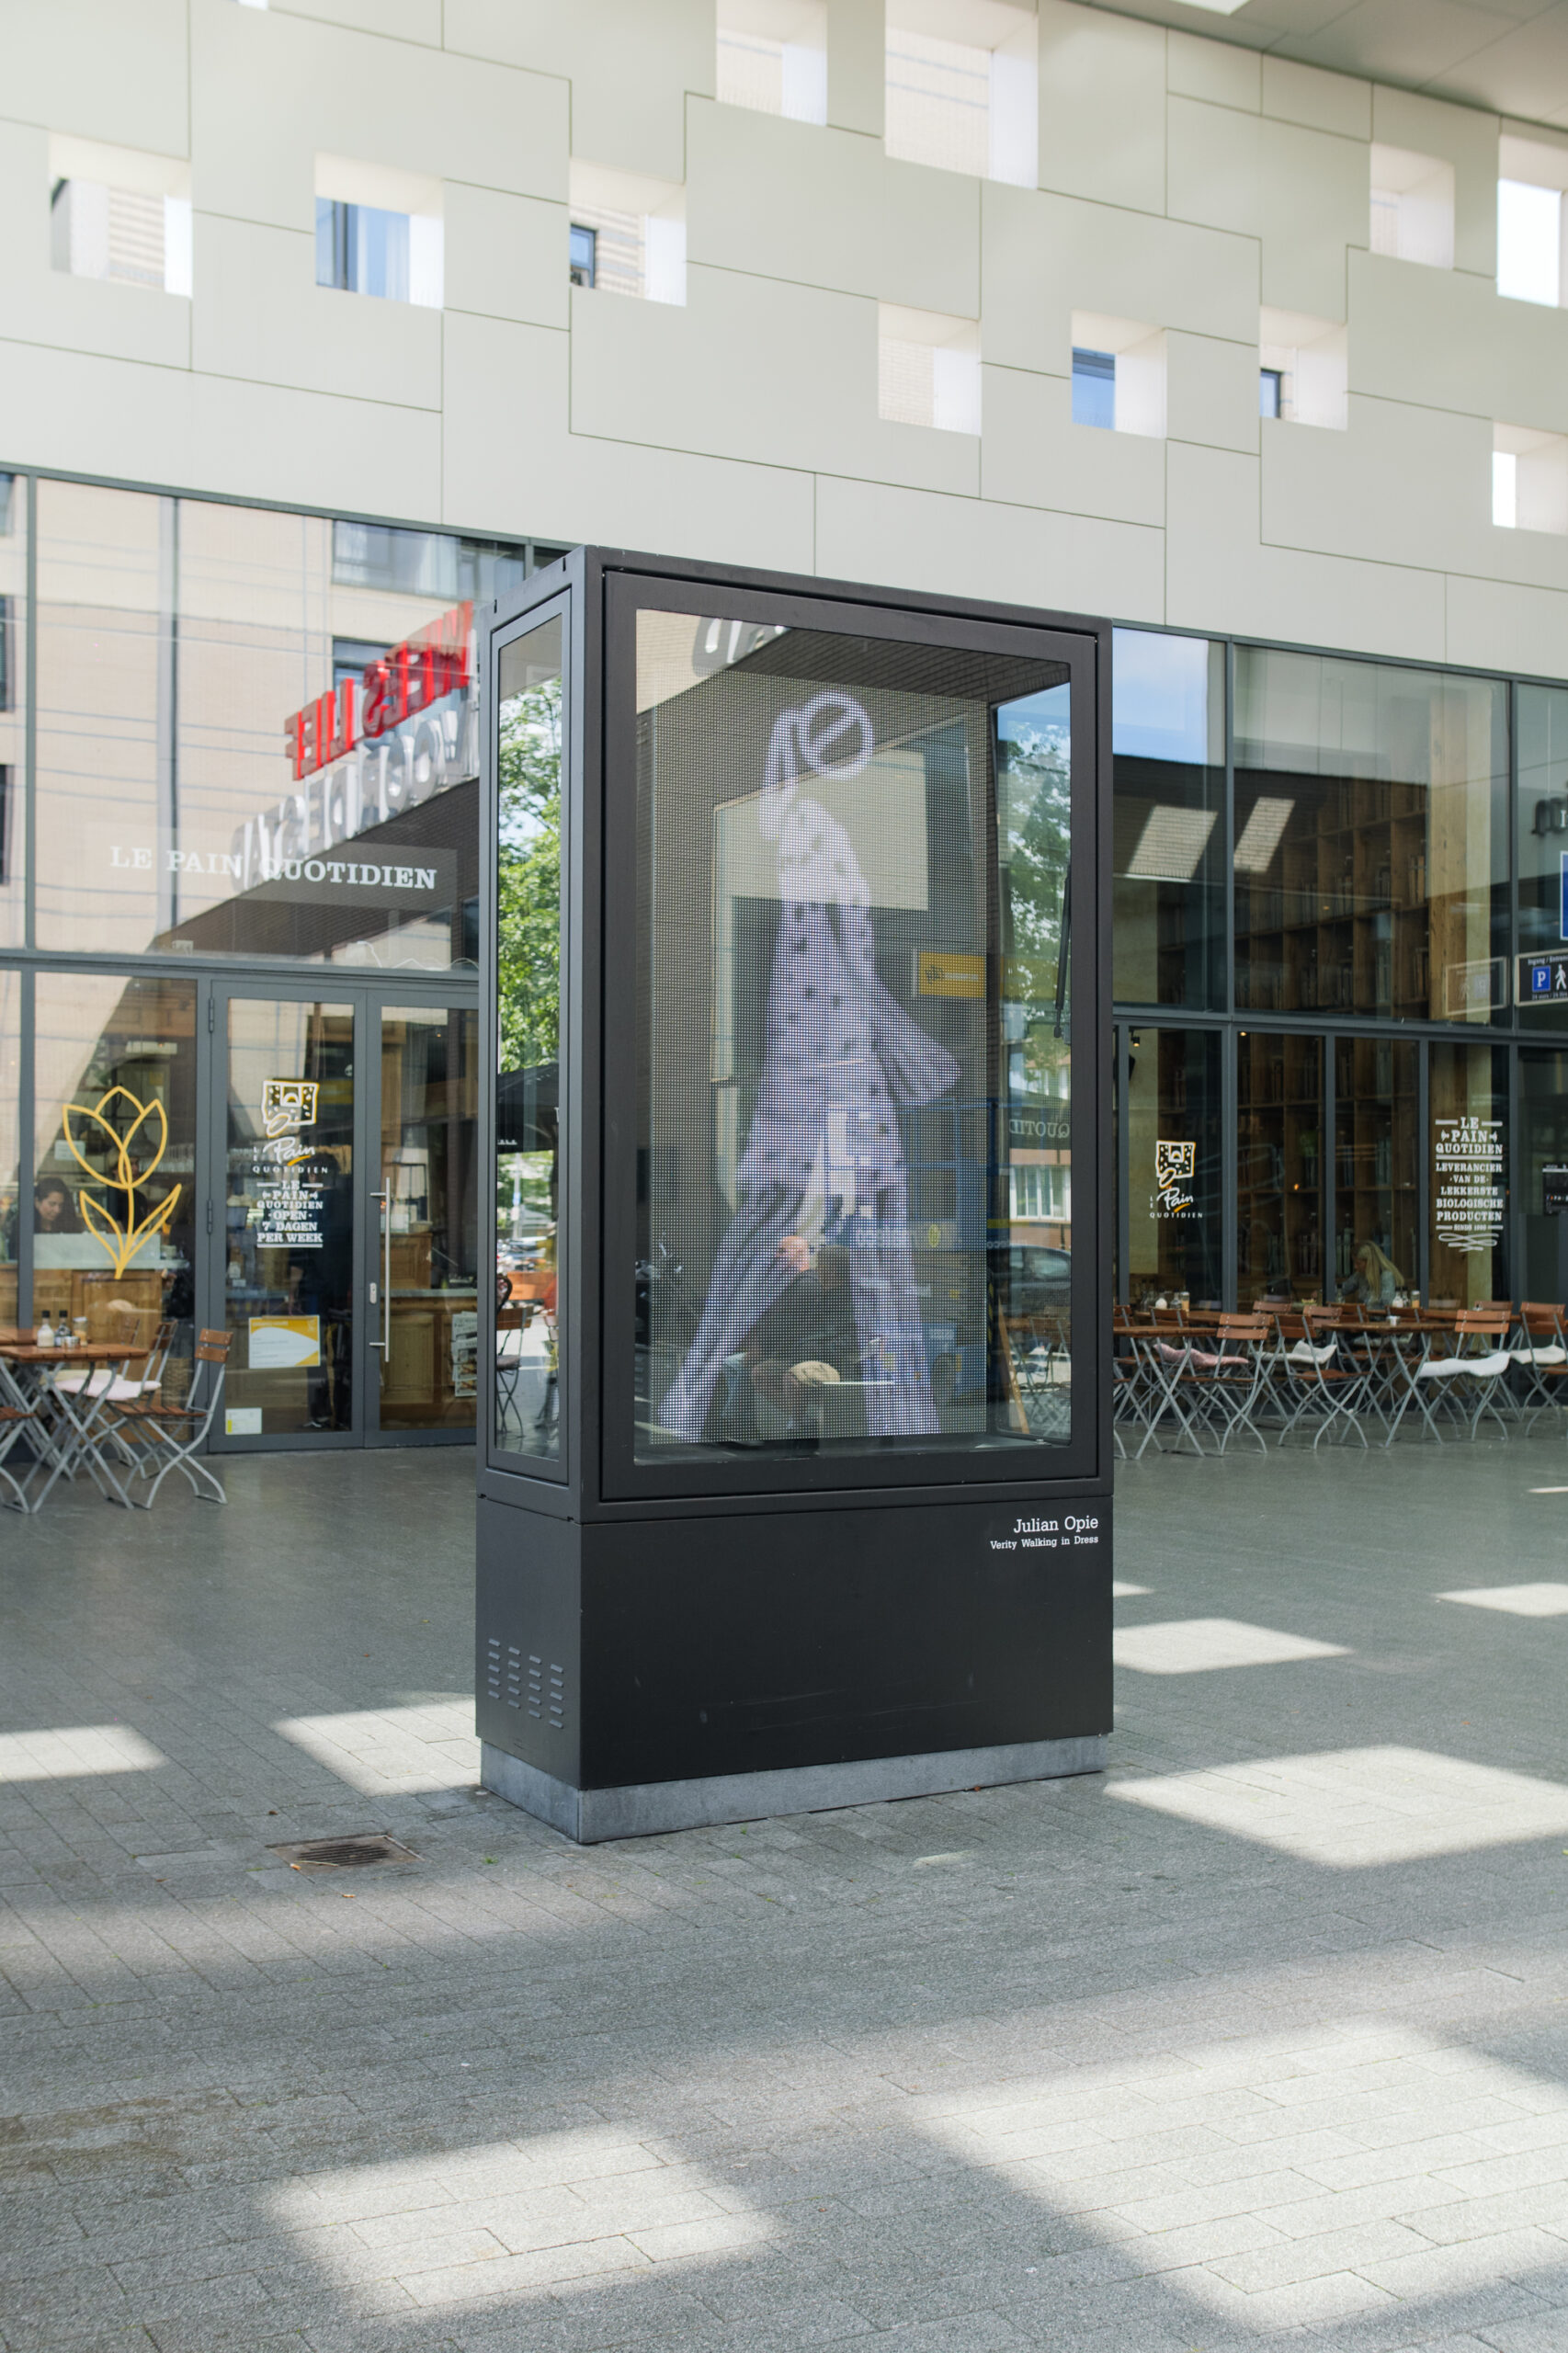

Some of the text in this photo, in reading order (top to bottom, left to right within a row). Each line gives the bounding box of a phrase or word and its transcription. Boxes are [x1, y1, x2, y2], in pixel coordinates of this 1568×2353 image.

[110, 846, 437, 890] LE PAIN QUOTIDIEN
[1537, 971, 1546, 988] P
[1460, 1116, 1479, 1130] LE
[1451, 1130, 1487, 1142] PAIN
[262, 1136, 316, 1165] Pain
[1435, 1142, 1504, 1154] QUOTIDIEN
[252, 1165, 329, 1175] QUOTIDIEN
[1435, 1162, 1503, 1173] LEVERANCIER
[1453, 1174, 1486, 1184] VAN DE
[281, 1180, 301, 1190] LE
[272, 1189, 309, 1200] PAIN
[1440, 1186, 1498, 1196] LEKKERSTE
[1155, 1187, 1194, 1211] Pain
[1436, 1198, 1504, 1209] BIOLOGISCHE
[256, 1200, 324, 1210] QUOTIDIEN
[272, 1210, 308, 1221] OPEN
[1436, 1211, 1503, 1222] PRODUCTEN
[262, 1221, 318, 1232] 7 DAGEN
[256, 1233, 324, 1244] PER WEEK
[1013, 1515, 1099, 1533] Julian Opie
[990, 1535, 1099, 1551] Verity Walking in Dress
